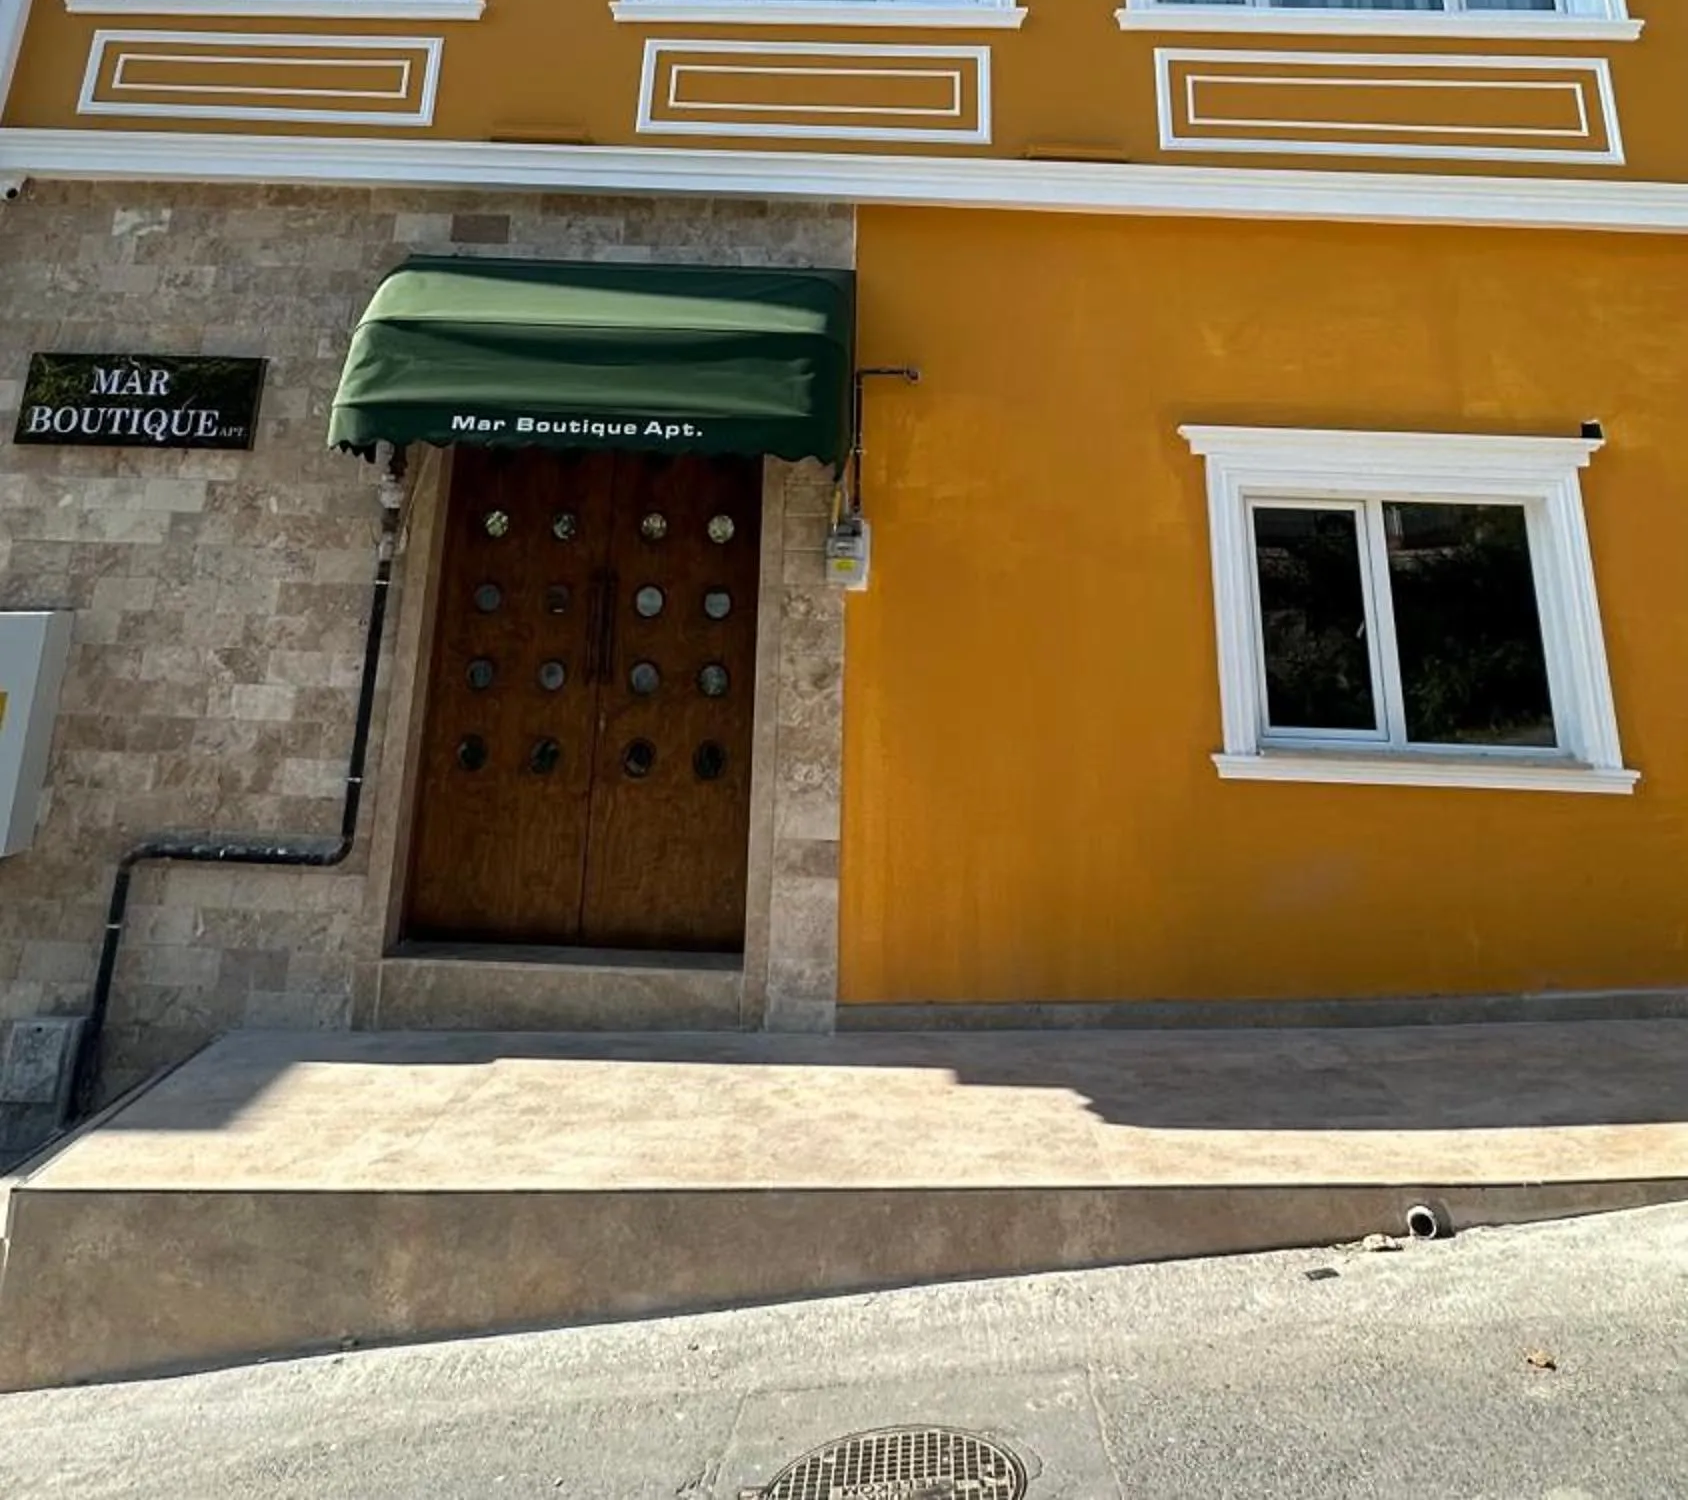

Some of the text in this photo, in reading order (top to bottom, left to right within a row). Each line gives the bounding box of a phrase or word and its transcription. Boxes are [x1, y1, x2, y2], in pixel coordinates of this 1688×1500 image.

[90, 367, 170, 396] MAR
[27, 405, 220, 441] BOUTIQUE
[451, 415, 703, 439] Mar Boutique Apt.
